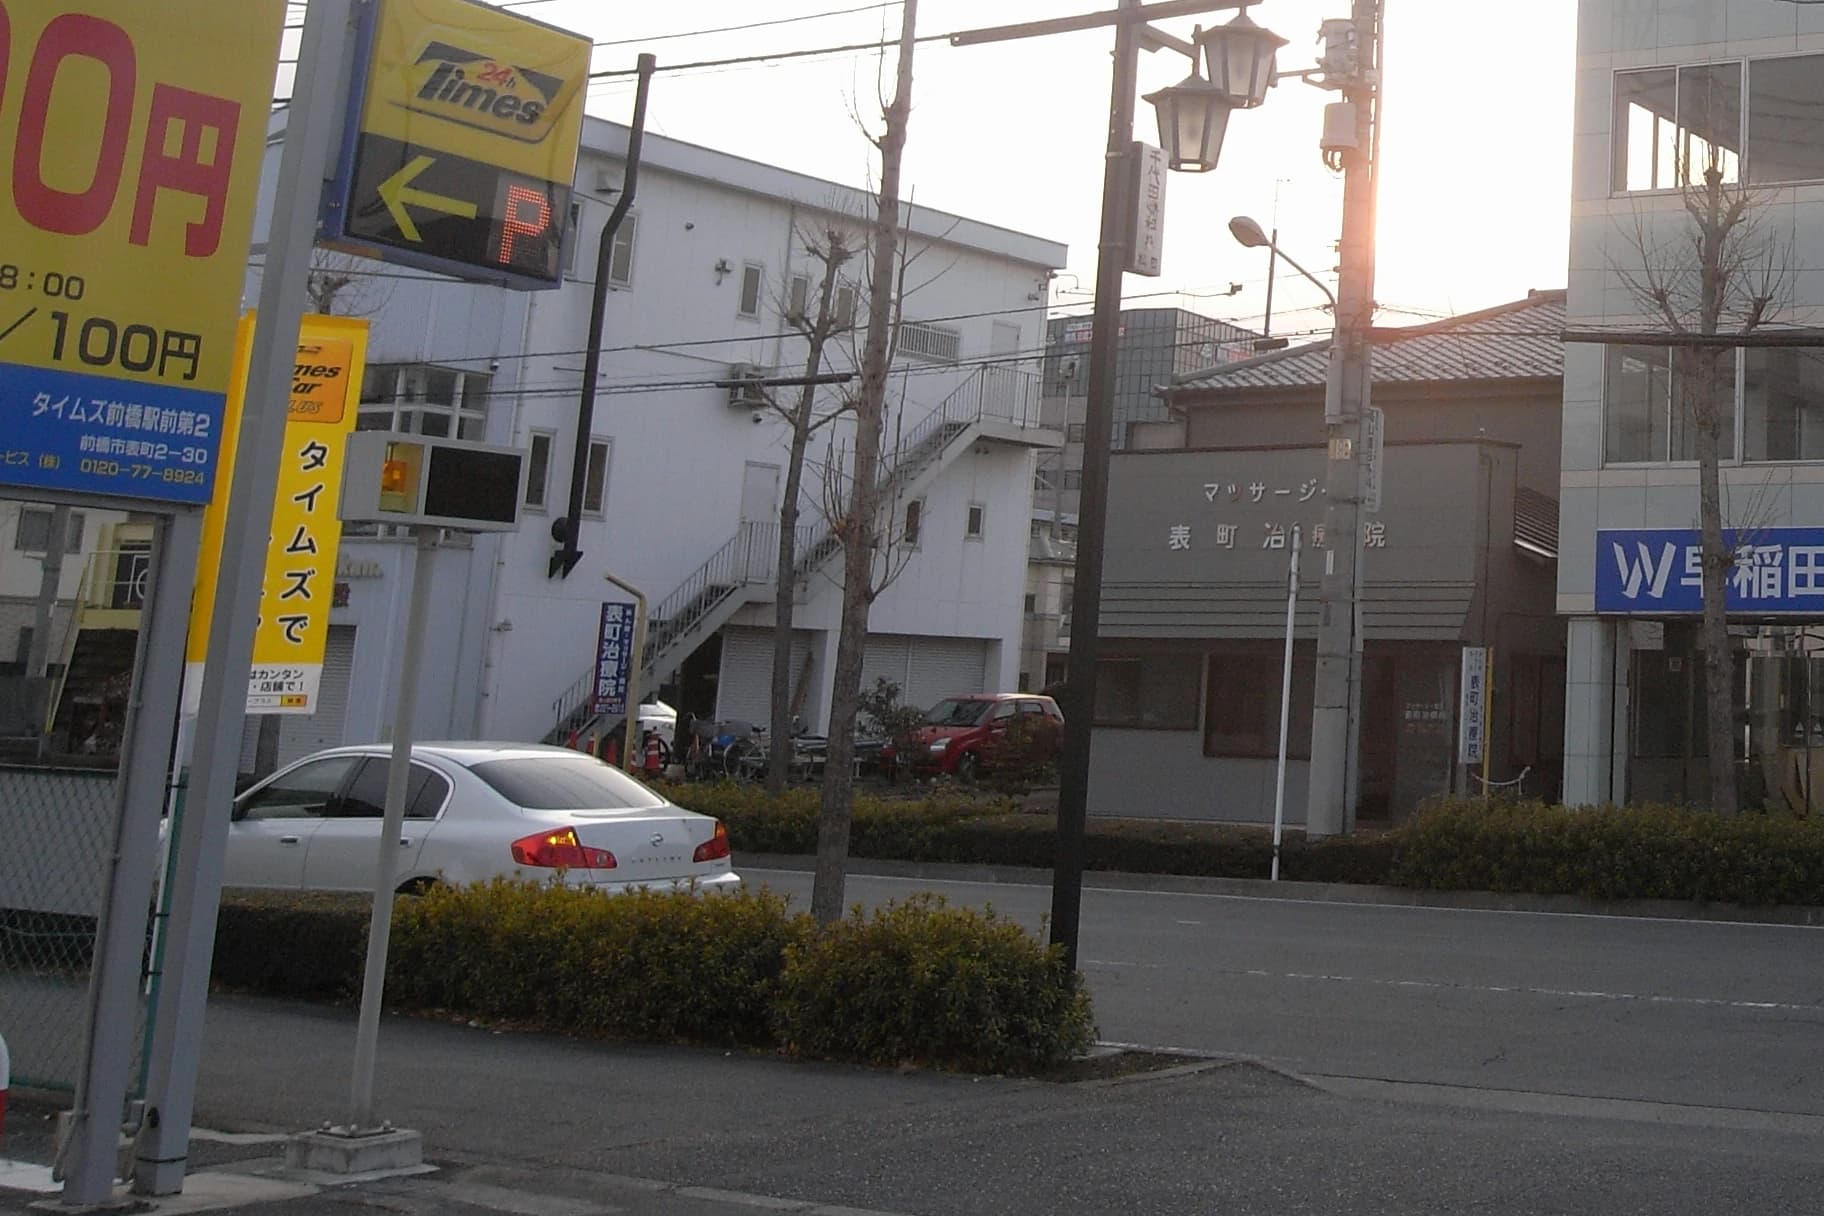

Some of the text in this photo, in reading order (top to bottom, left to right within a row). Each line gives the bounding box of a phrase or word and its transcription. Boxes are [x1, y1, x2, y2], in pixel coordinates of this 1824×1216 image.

[415, 58, 546, 126] Times
[498, 184, 552, 265] P
[32, 391, 212, 437] タイムズ前橋駅前第2
[292, 377, 323, 394] ar
[277, 440, 328, 644] タイムズで
[598, 604, 623, 697] 表町治療院
